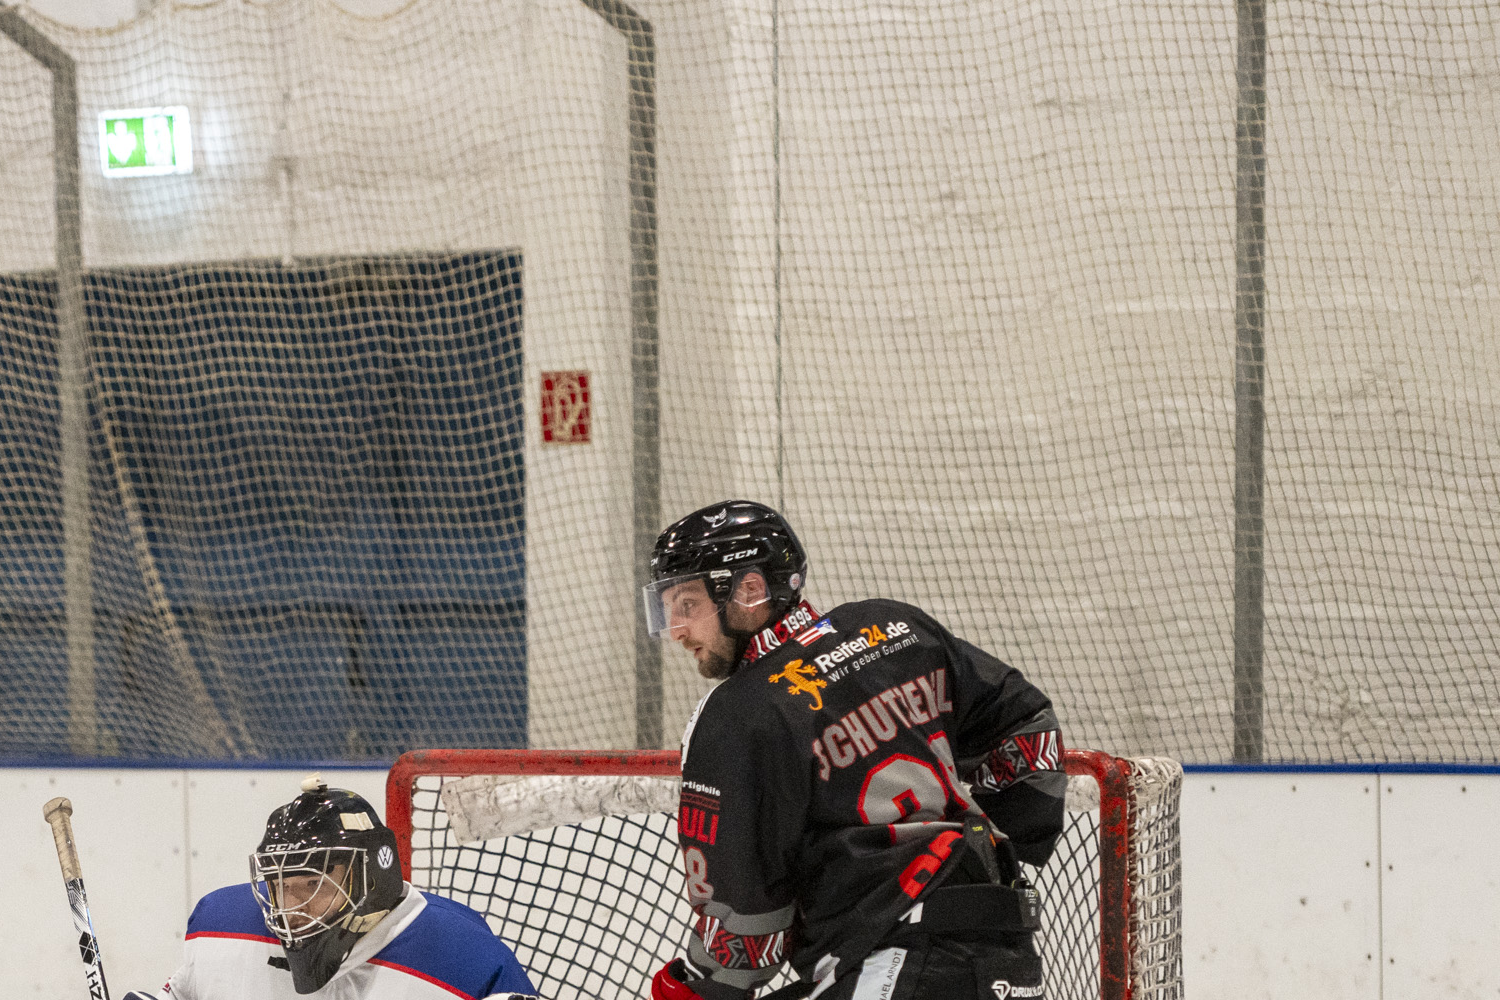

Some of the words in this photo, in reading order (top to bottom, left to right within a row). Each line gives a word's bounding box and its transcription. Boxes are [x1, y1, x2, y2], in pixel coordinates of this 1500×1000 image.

[722, 547, 759, 563] CCM
[782, 606, 813, 634] 1996
[814, 611, 911, 674] Reifen24.de
[828, 658, 850, 683] Wir
[852, 649, 882, 672] geben
[881, 633, 920, 656] Gummi!
[678, 806, 719, 846] ULI
[264, 842, 302, 853] CCM
[888, 951, 903, 981] ARNDT
